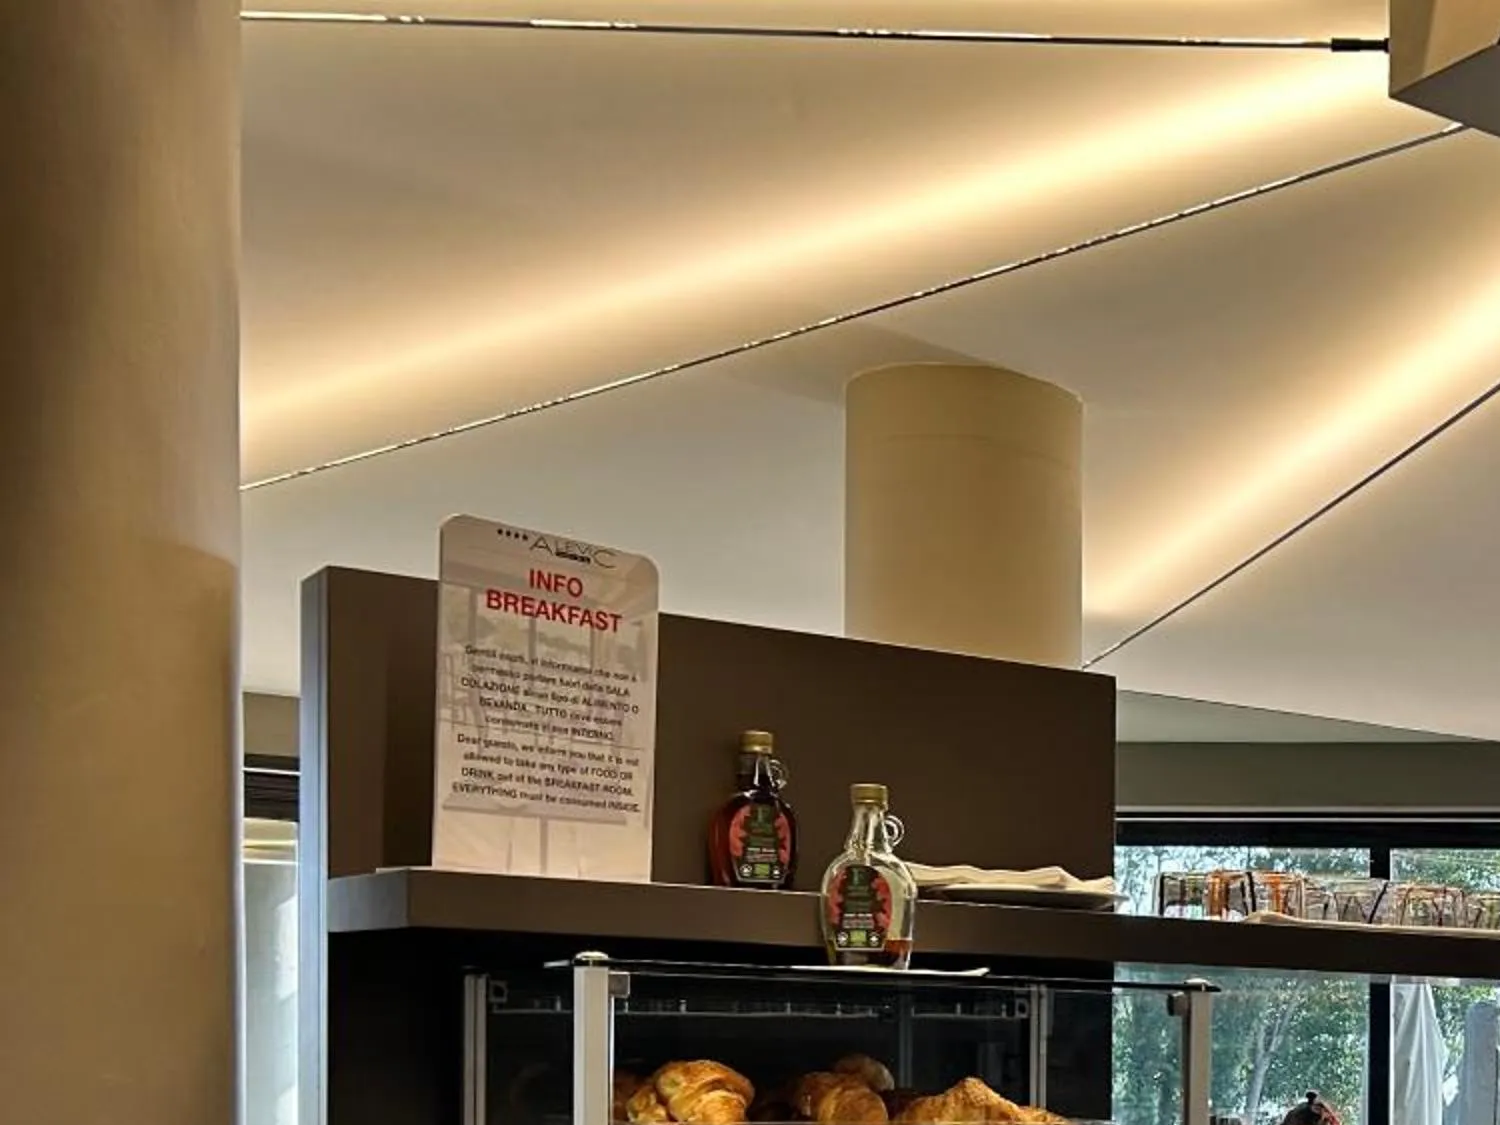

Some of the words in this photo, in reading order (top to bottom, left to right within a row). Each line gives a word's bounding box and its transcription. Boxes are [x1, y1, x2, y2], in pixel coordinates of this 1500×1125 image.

[529, 568, 583, 598] INFO
[486, 588, 622, 633] BREAKFAST
[535, 704, 567, 719] TUTTO
[457, 733, 481, 745] Dear
[587, 752, 605, 763] that
[504, 757, 513, 766] to
[557, 764, 577, 776] type
[544, 777, 600, 793] BREAKFAST
